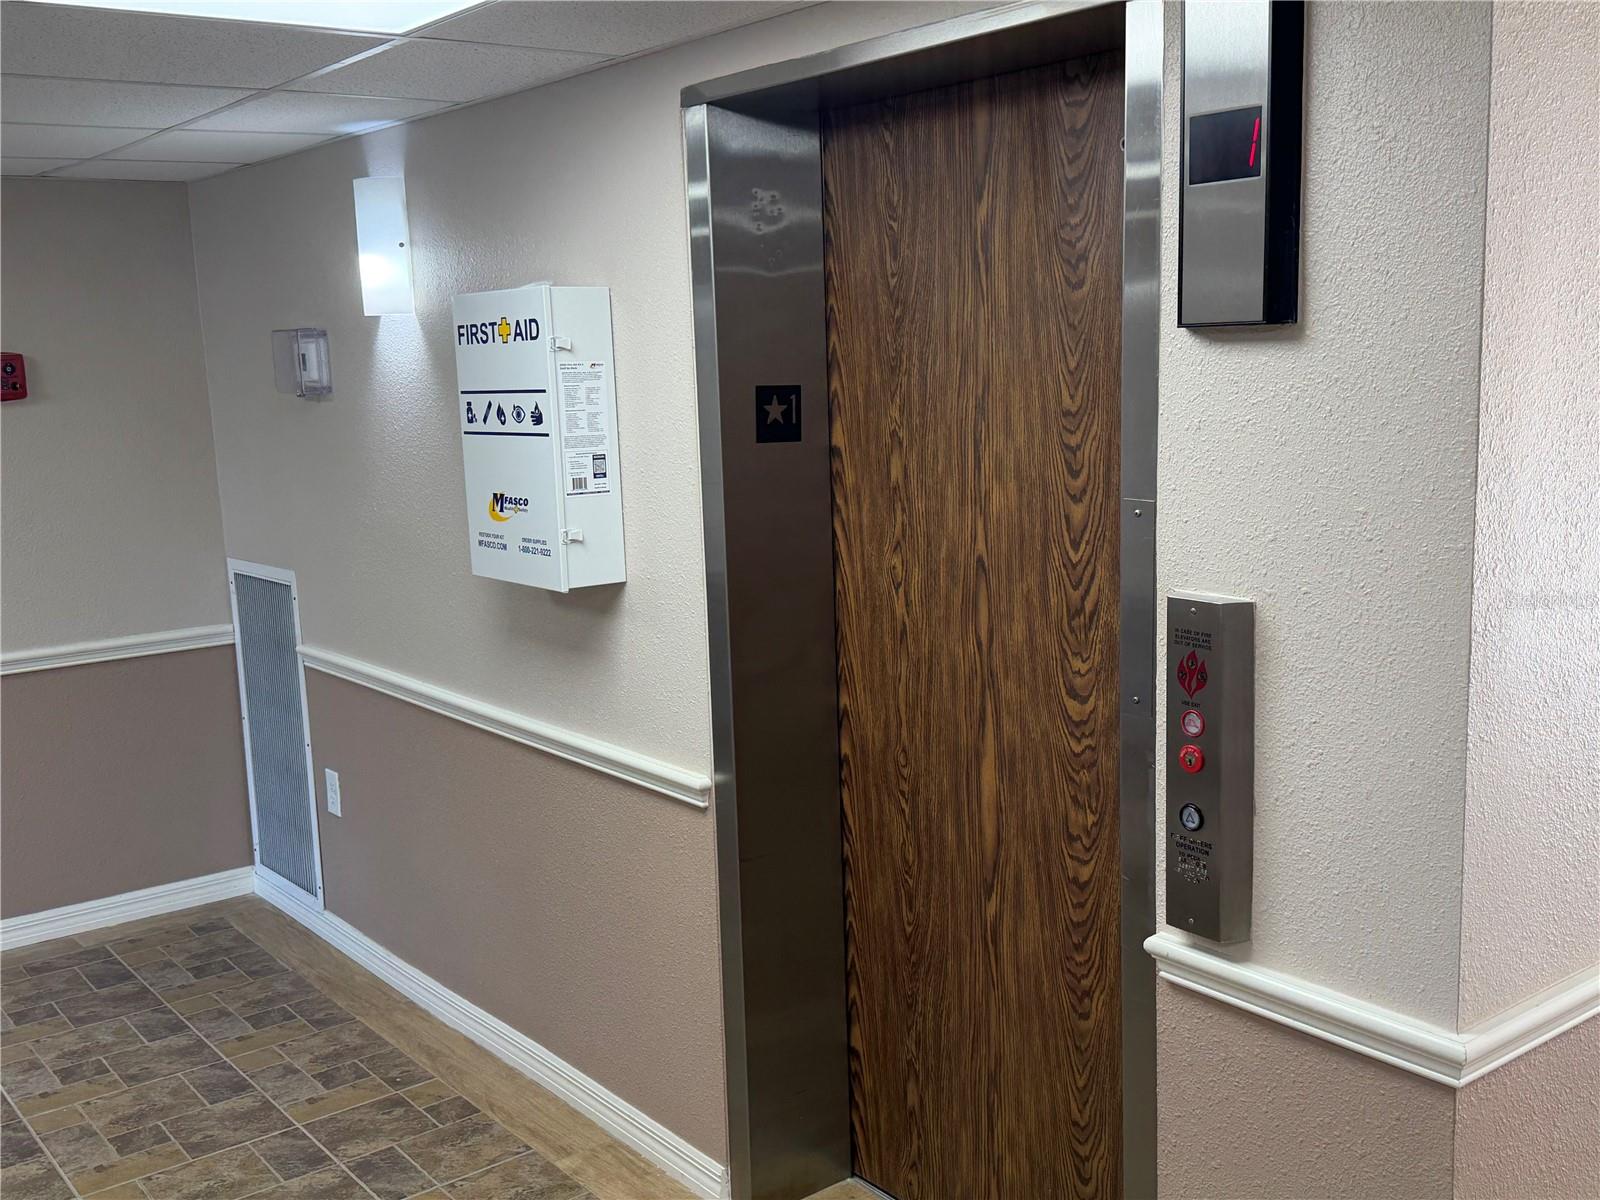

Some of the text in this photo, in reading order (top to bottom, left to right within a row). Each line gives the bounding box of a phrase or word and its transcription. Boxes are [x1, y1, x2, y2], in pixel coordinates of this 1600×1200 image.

[1248, 116, 1260, 169] 1
[457, 318, 540, 345] FIRST AID
[790, 393, 797, 425] 1
[492, 492, 529, 513] MFASCO
[478, 539, 508, 551] MFASCO.COM
[1175, 841, 1210, 857] OPERATION
